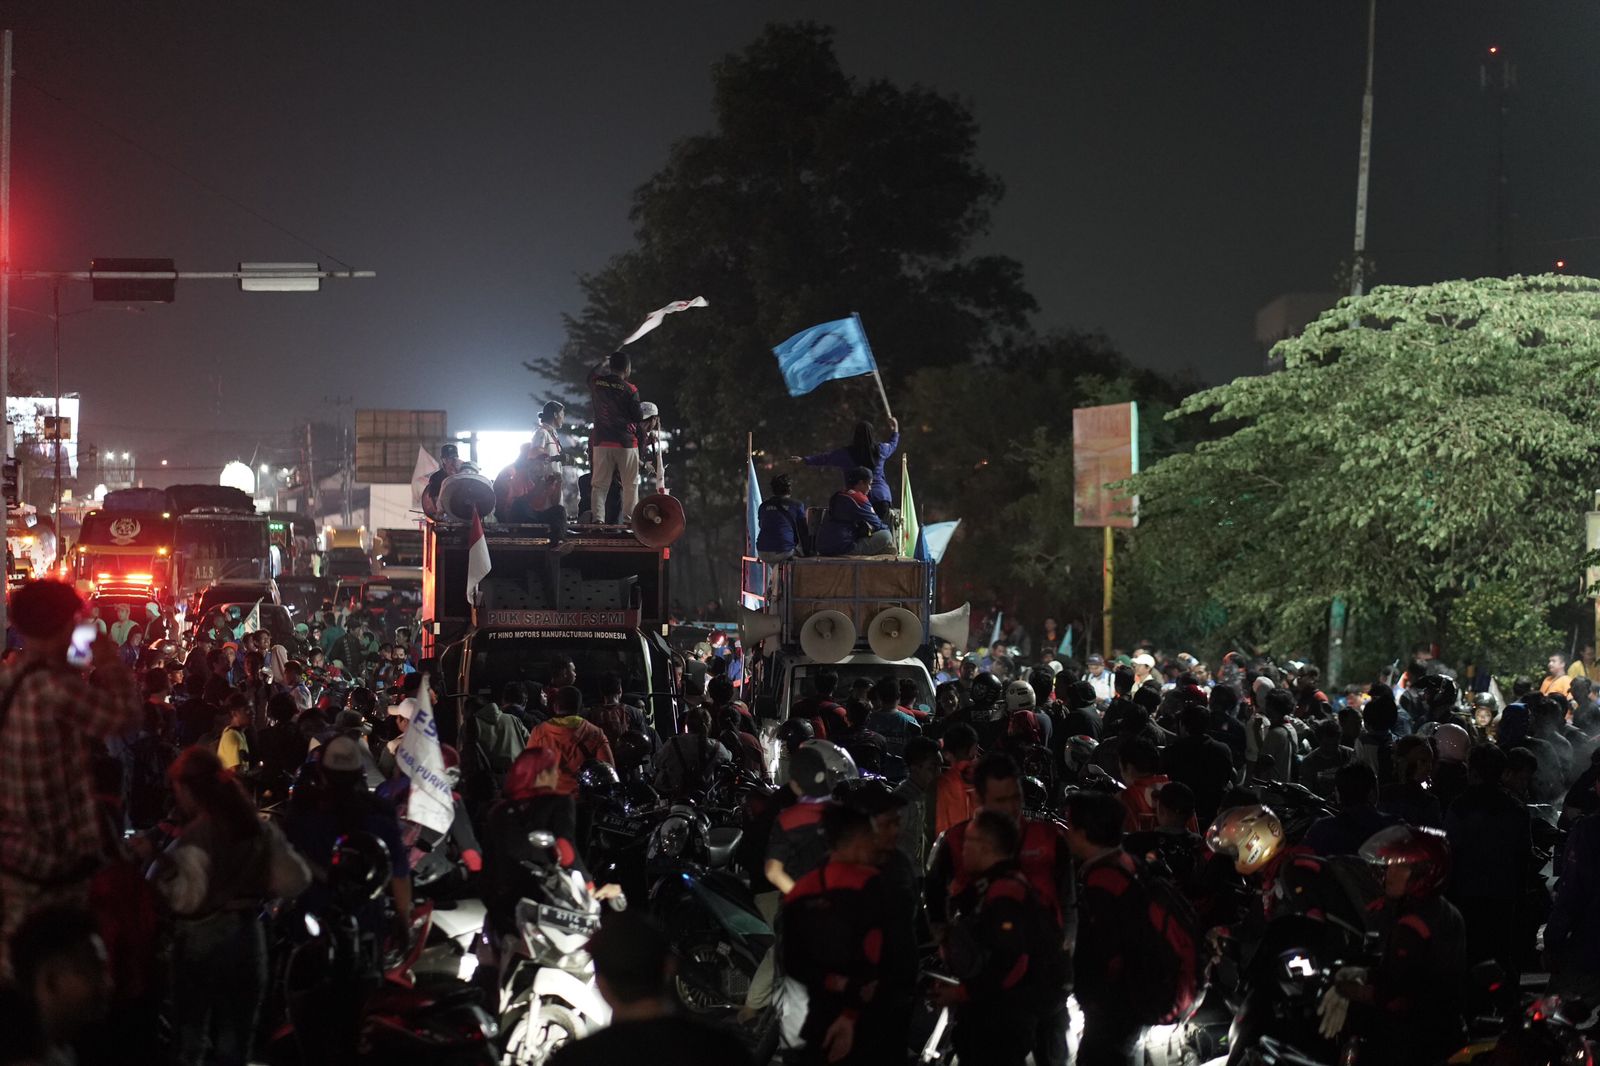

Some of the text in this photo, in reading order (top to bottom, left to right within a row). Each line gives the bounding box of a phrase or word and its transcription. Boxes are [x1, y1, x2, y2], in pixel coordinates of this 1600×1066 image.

[487, 611, 625, 626] PUK SPAMK FSPMI
[488, 630, 627, 640] PT HINO MOTORS MANUFACTURING INDONESIA
